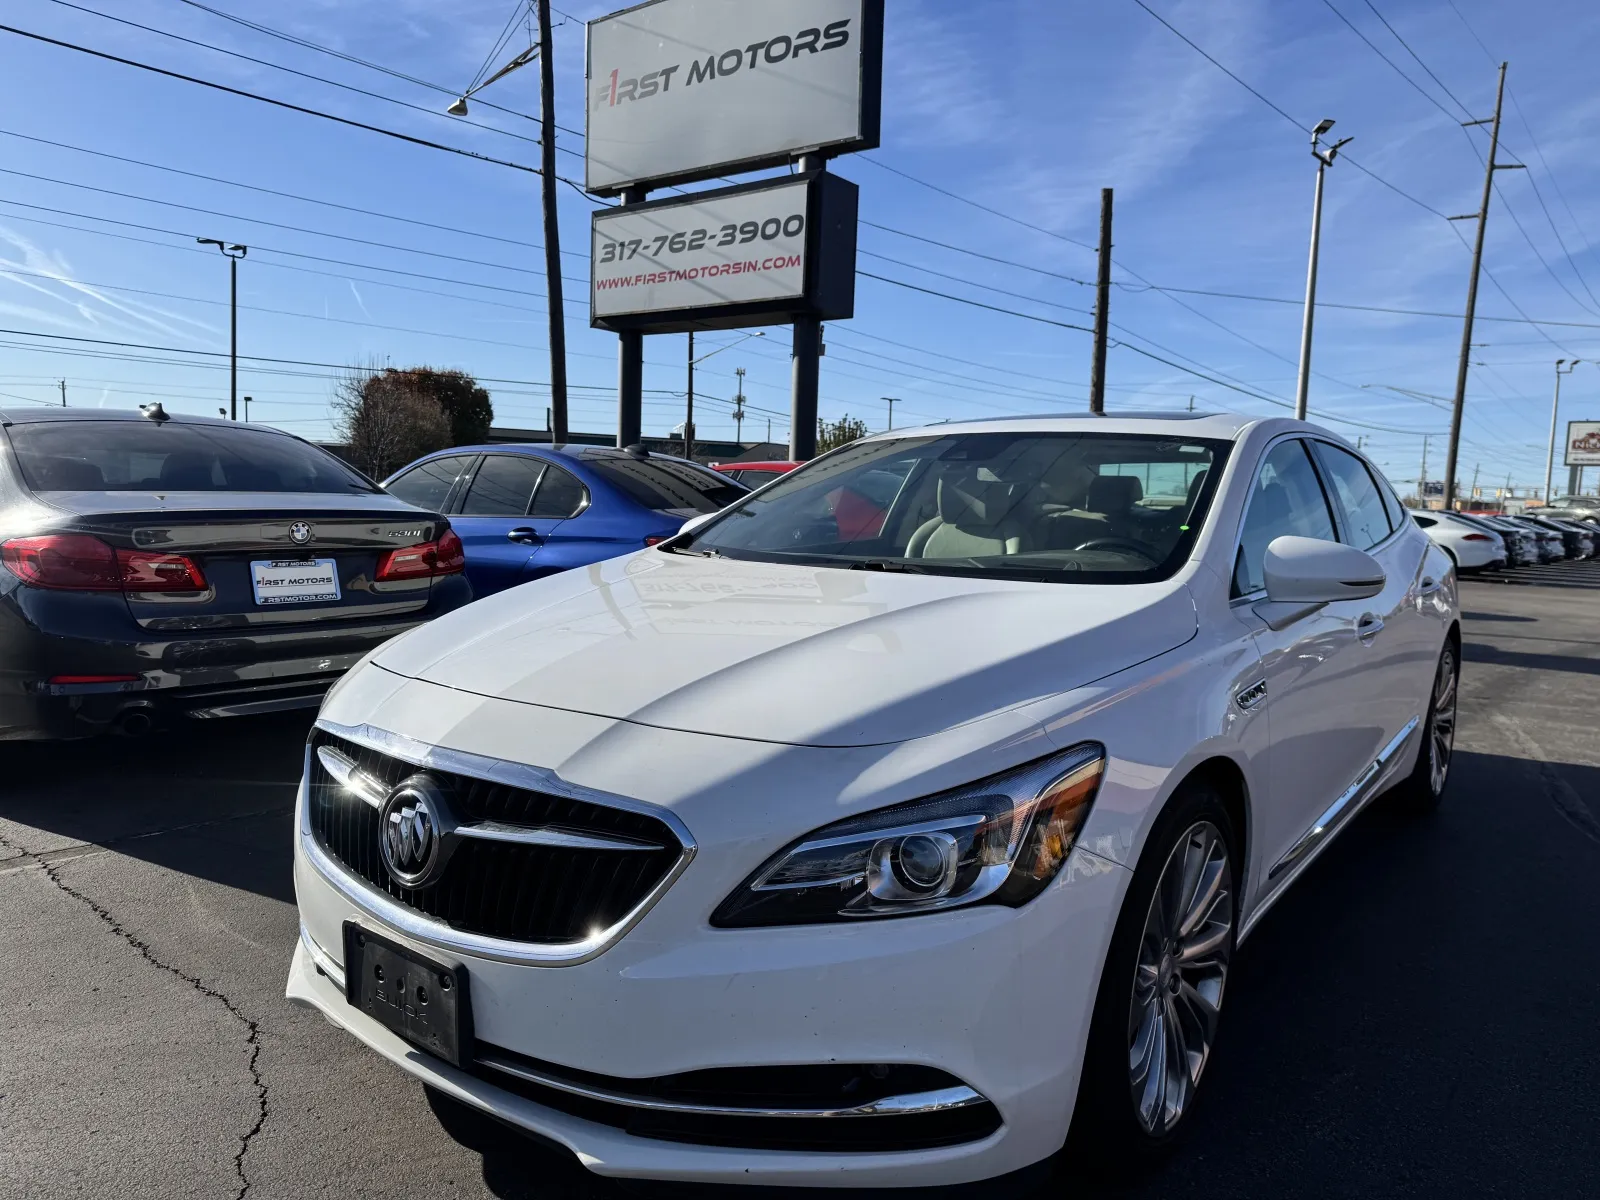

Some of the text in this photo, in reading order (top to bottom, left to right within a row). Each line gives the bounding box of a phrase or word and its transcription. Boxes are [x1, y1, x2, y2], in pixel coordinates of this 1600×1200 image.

[686, 19, 851, 86] MOTORS
[600, 214, 804, 264] 317-762-3900
[597, 255, 801, 291] WWW.FIRSTMOTORSIN.COM
[288, 577, 333, 585] MOTORS
